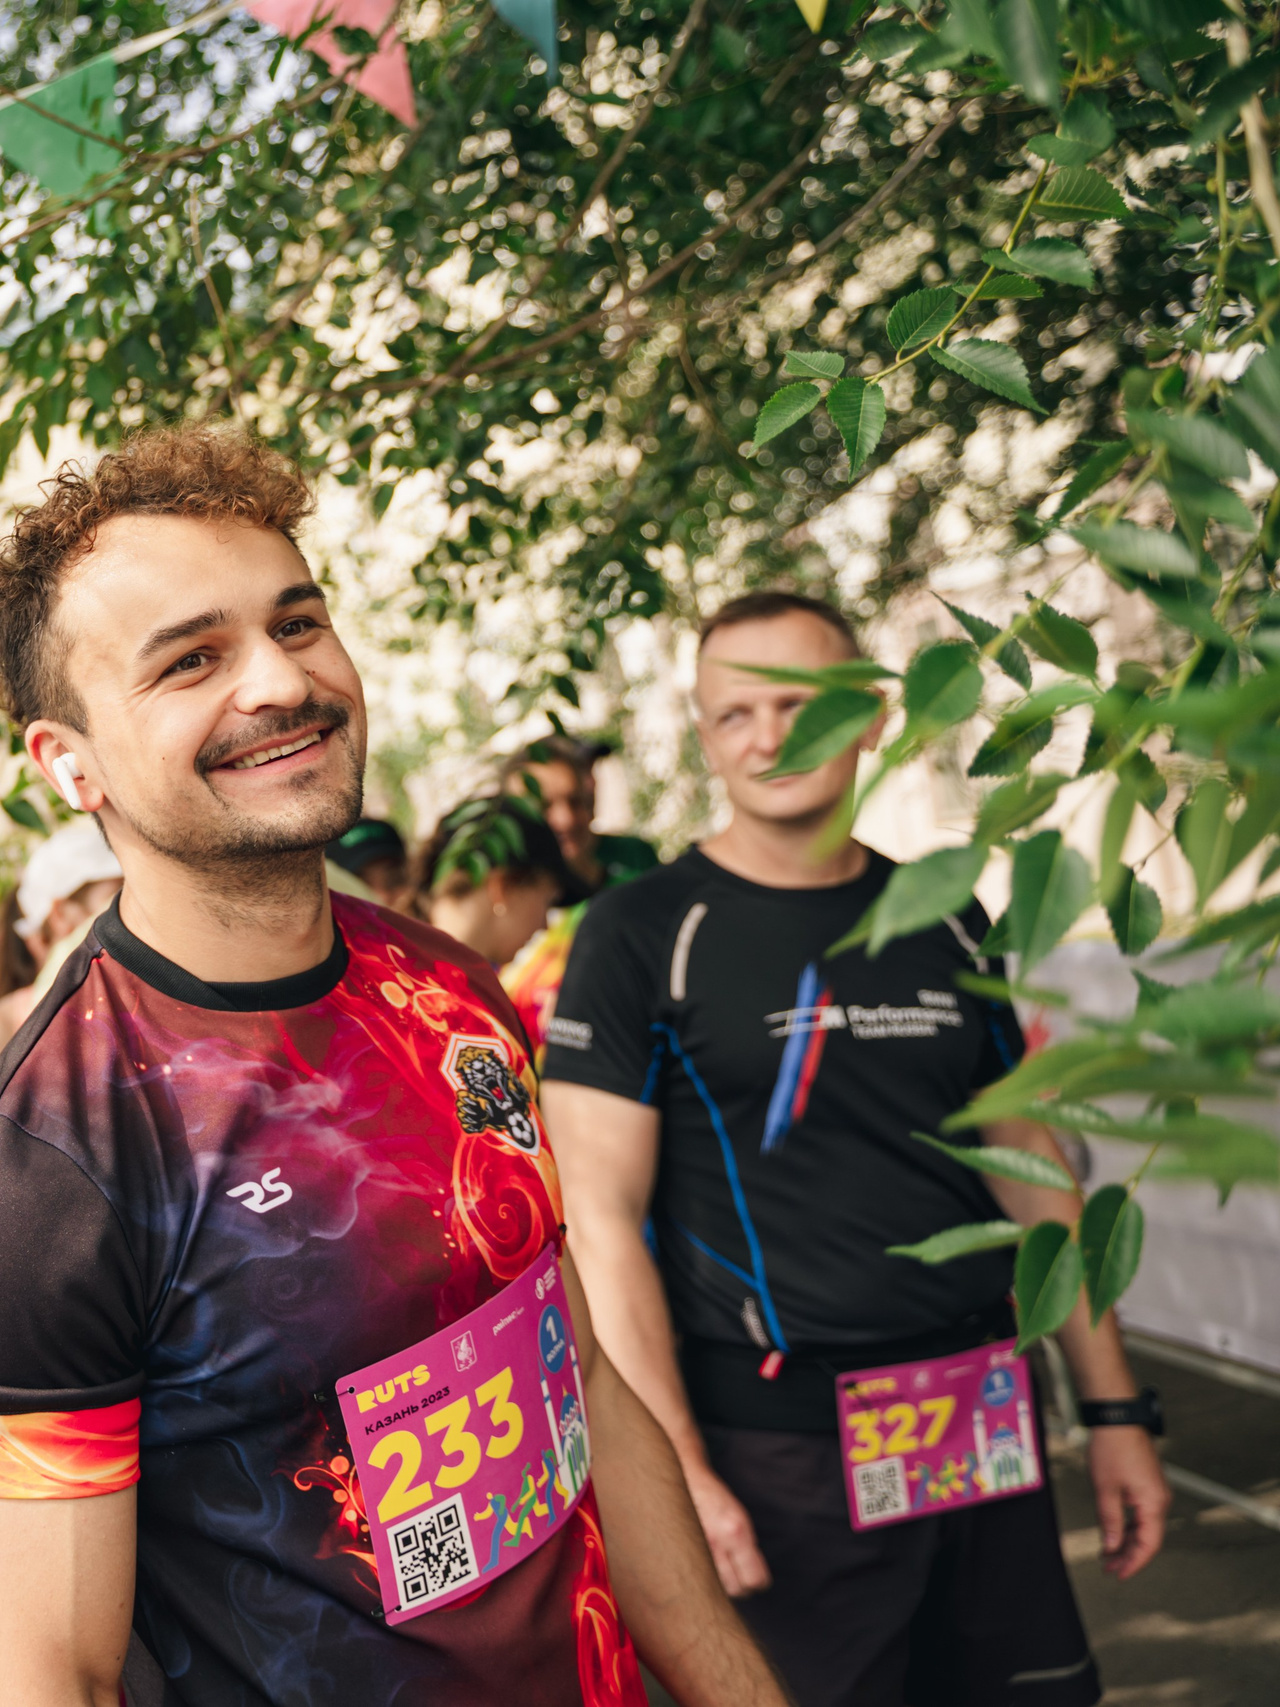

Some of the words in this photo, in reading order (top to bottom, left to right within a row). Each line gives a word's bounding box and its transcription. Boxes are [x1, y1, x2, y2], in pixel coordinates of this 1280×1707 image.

[847, 1004, 964, 1028] Performance
[546, 1315, 558, 1342] 1
[356, 1364, 431, 1413] RUTS
[365, 1404, 420, 1436] КАЗАНЬ
[421, 1386, 451, 1409] 2023
[367, 1366, 524, 1524] 233
[846, 1395, 956, 1462] 327
